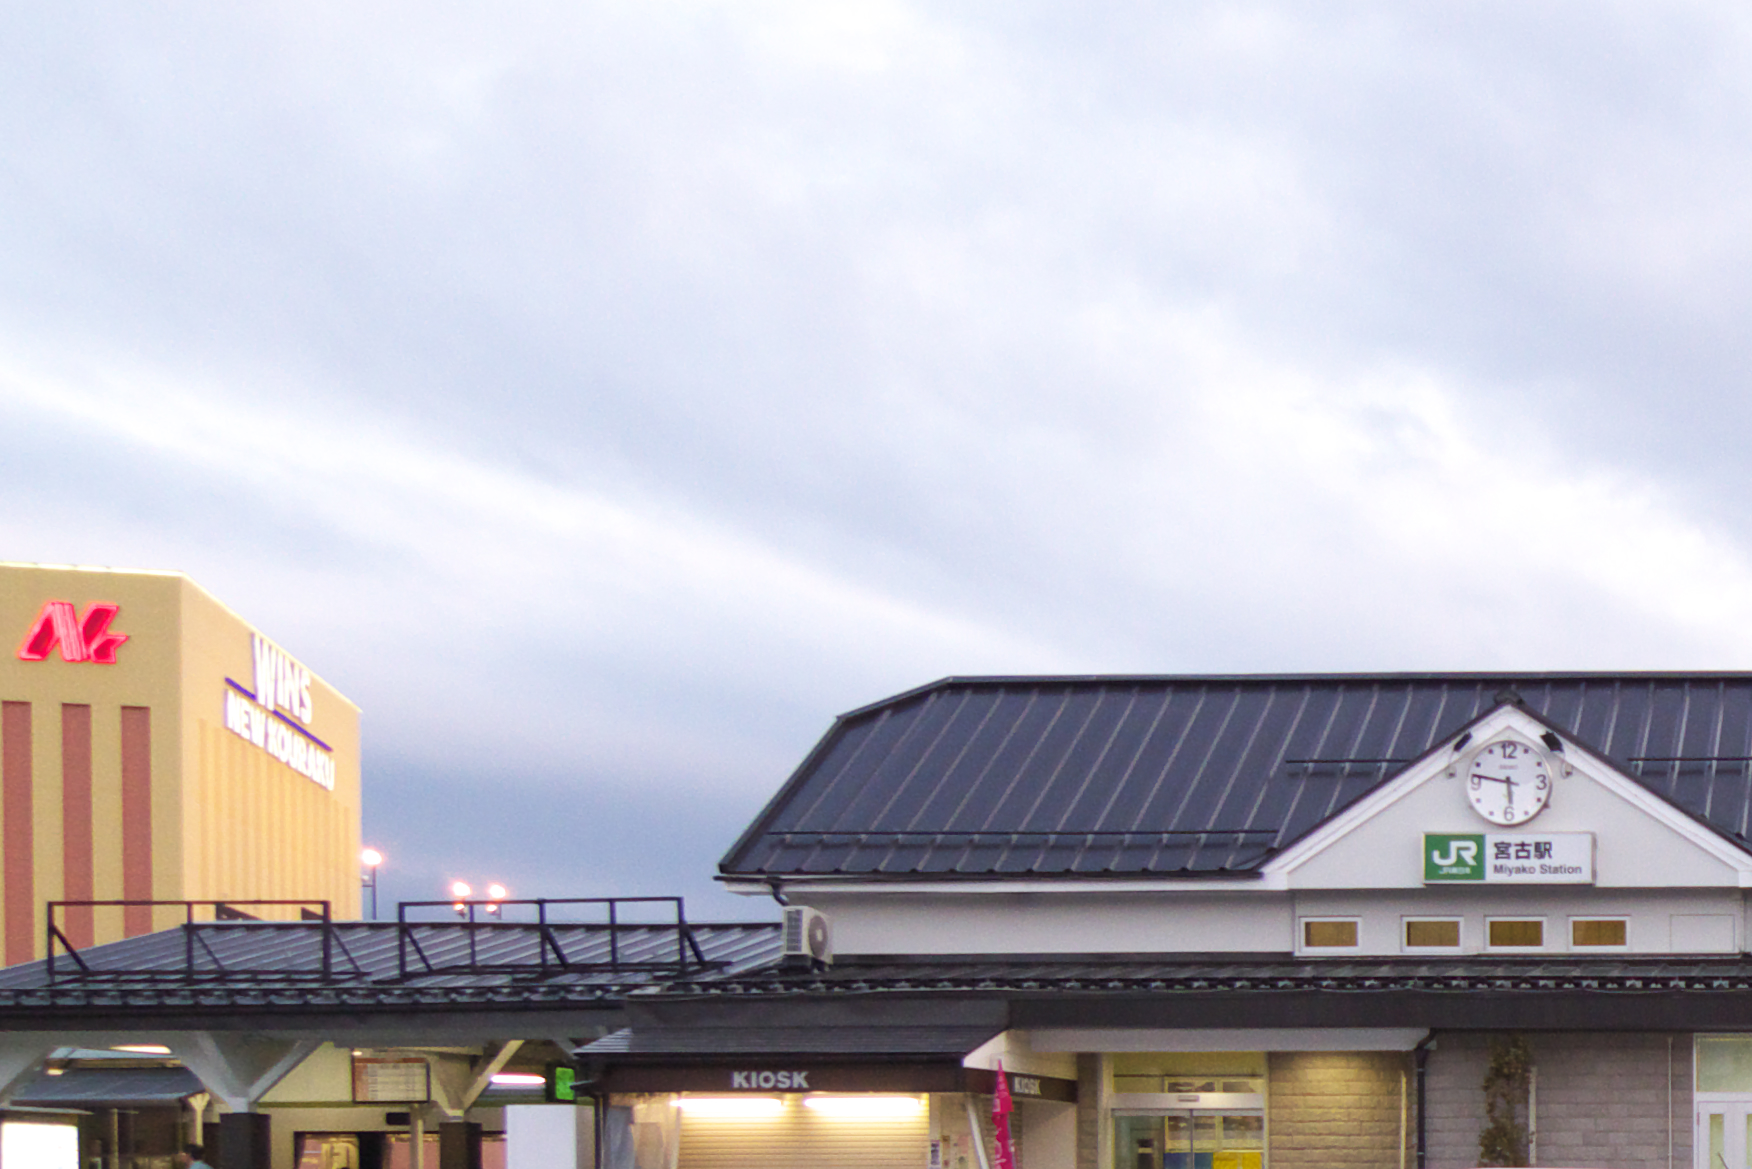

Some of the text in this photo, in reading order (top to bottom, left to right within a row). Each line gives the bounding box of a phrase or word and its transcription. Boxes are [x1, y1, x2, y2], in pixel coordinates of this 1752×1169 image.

[250, 632, 312, 725] WINS
[224, 689, 267, 749] NEW
[1501, 742, 1517, 759] 12
[1470, 773, 1481, 791] 9
[1535, 774, 1547, 790] 3
[1503, 806, 1515, 821] 6
[1432, 840, 1477, 866] JR
[1494, 842, 1552, 860] 宮古駅
[1493, 864, 1582, 877] Miyako Station
[732, 1071, 809, 1089] KIOSK
[1014, 1077, 1041, 1095] KIOSK
